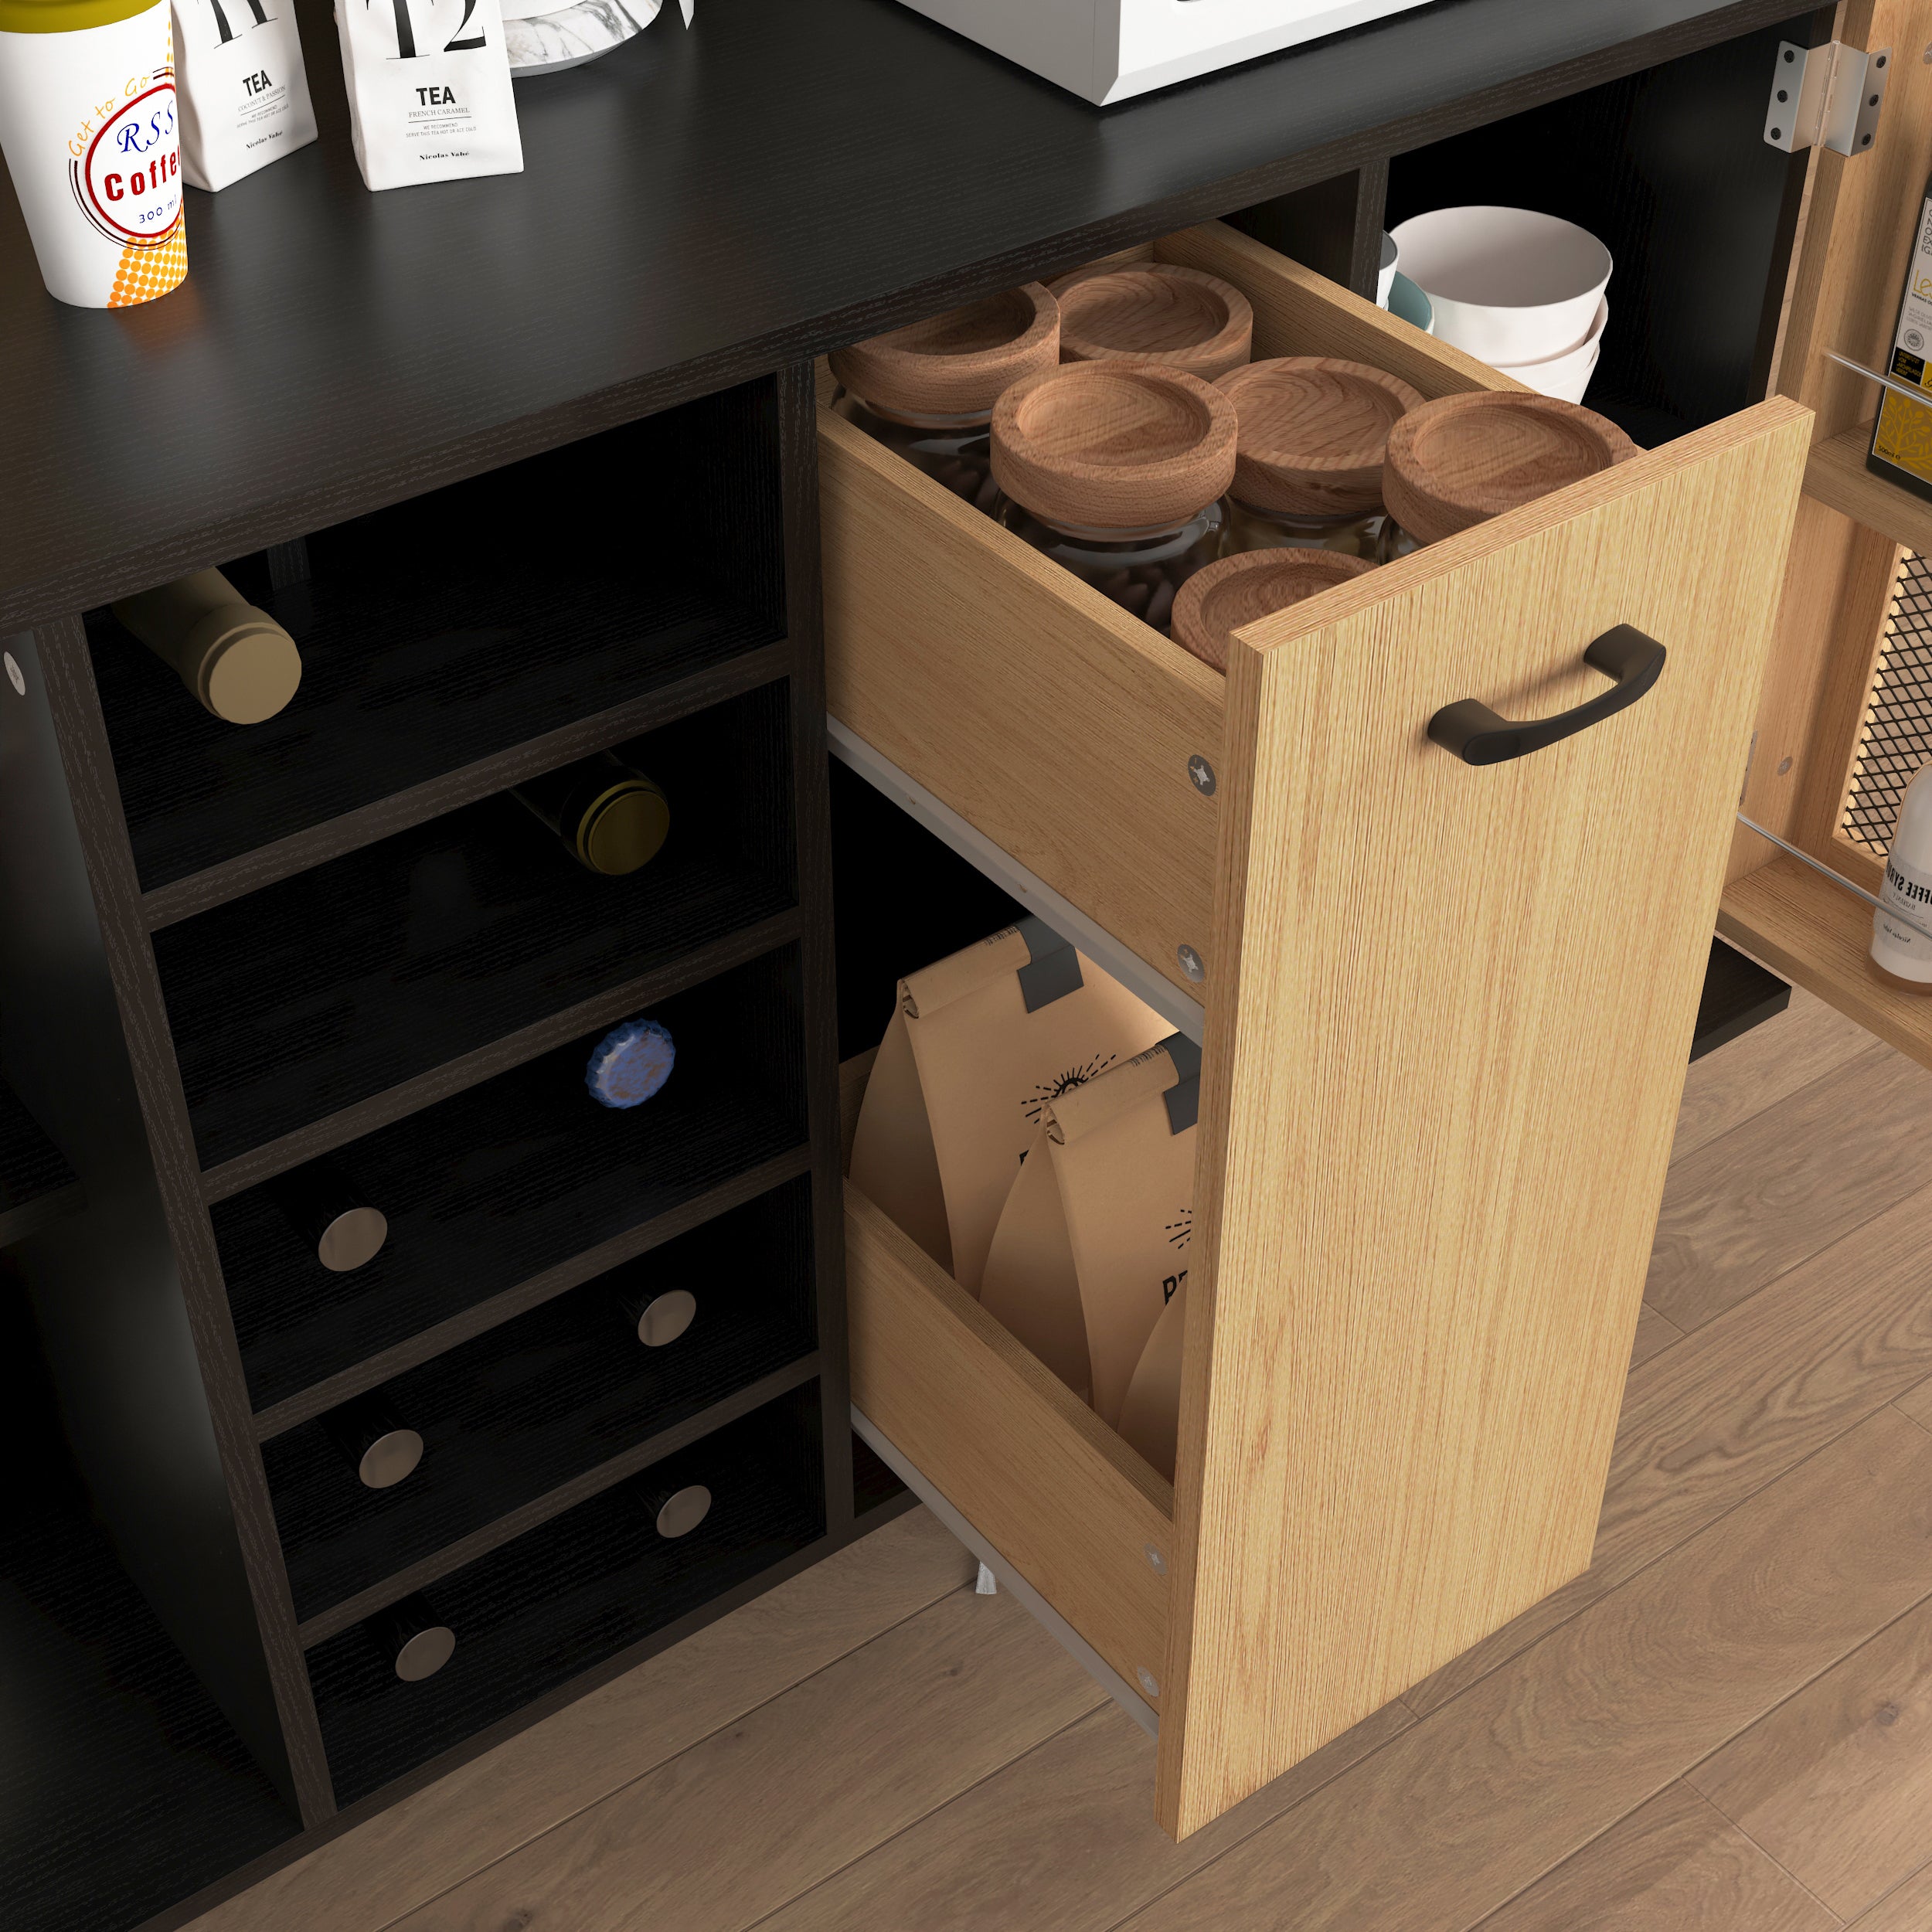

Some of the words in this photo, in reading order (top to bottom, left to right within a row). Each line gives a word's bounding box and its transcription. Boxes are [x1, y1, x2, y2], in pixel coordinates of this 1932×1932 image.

[243, 70, 272, 97] TEA
[266, 85, 286, 100] PASSION
[416, 86, 456, 106] TEA
[68, 120, 94, 158] Get
[94, 97, 116, 119] to
[124, 74, 151, 97] Go
[117, 100, 173, 153] RSS
[246, 138, 267, 148] Nicolas
[420, 152, 448, 161] Nicolas
[138, 206, 162, 223] 300
[167, 194, 177, 210] ml
